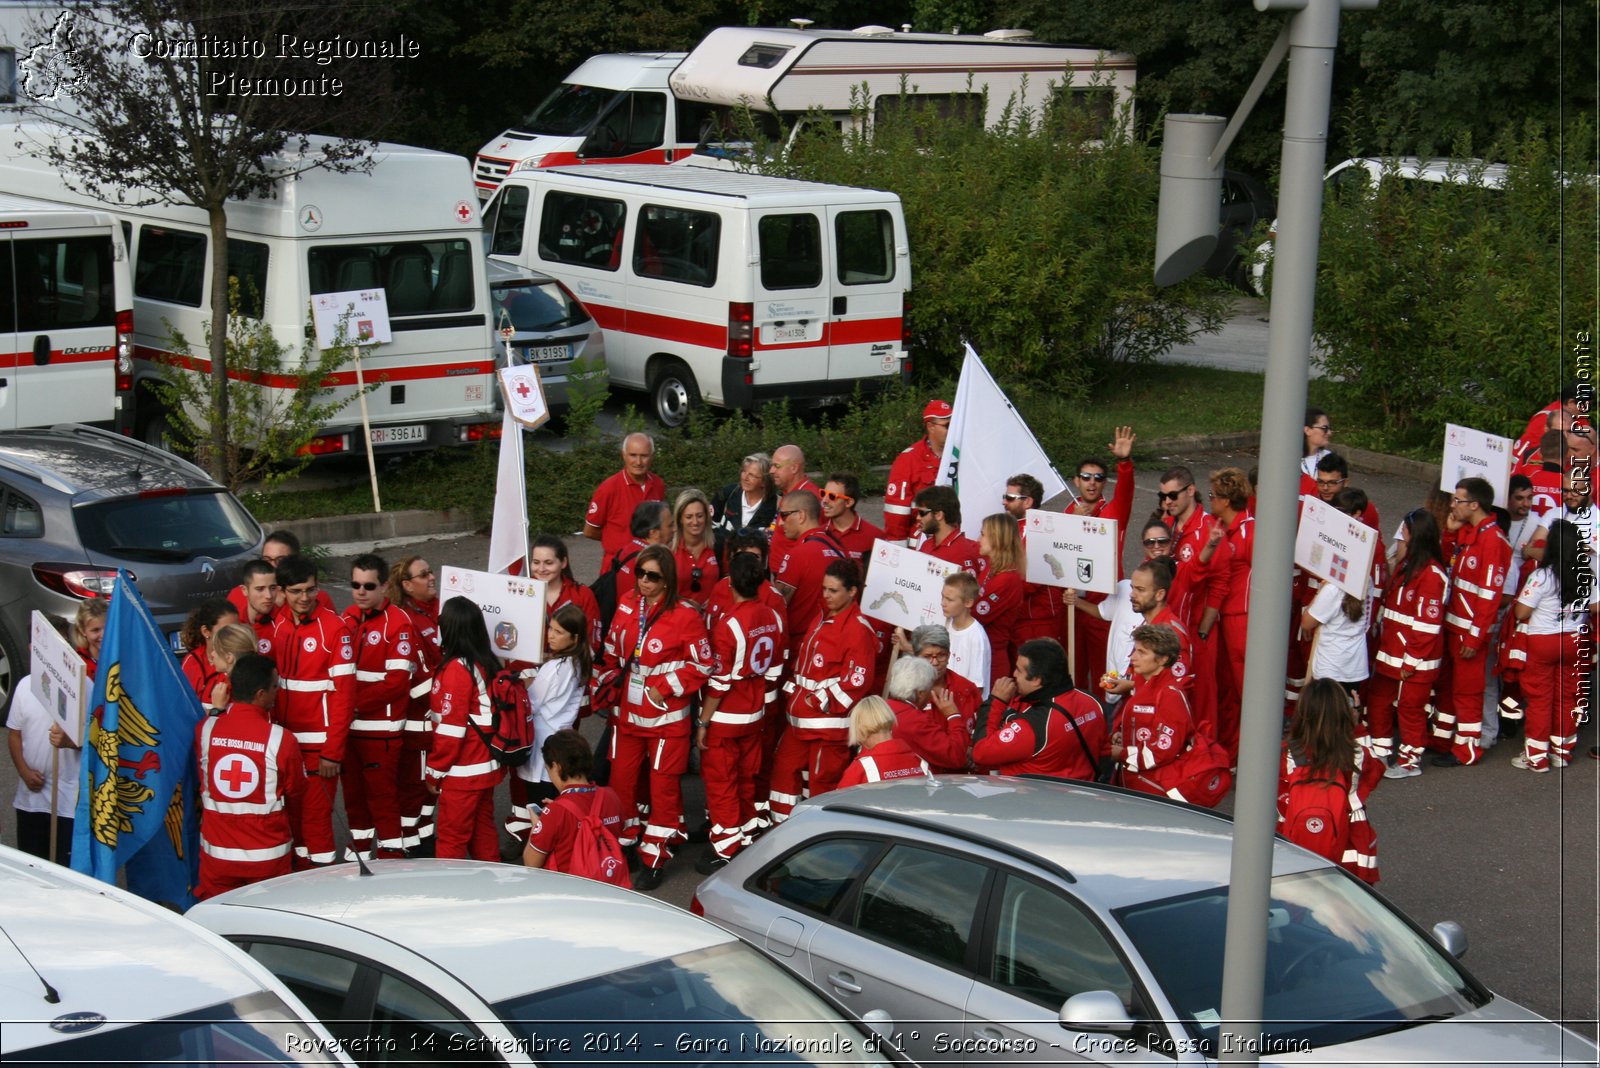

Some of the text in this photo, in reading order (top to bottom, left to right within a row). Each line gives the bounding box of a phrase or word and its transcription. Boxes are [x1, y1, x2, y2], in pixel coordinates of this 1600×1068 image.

[530, 346, 568, 360] BK 919SY
[1460, 454, 1488, 468] SARDEGNA
[1053, 541, 1083, 552] MARCHE
[1318, 531, 1347, 552] PIEMONTE
[895, 576, 922, 592] LIGURIA
[480, 605, 501, 614] AZIO
[212, 737, 265, 752] CROCE ROSSA ITALIANA
